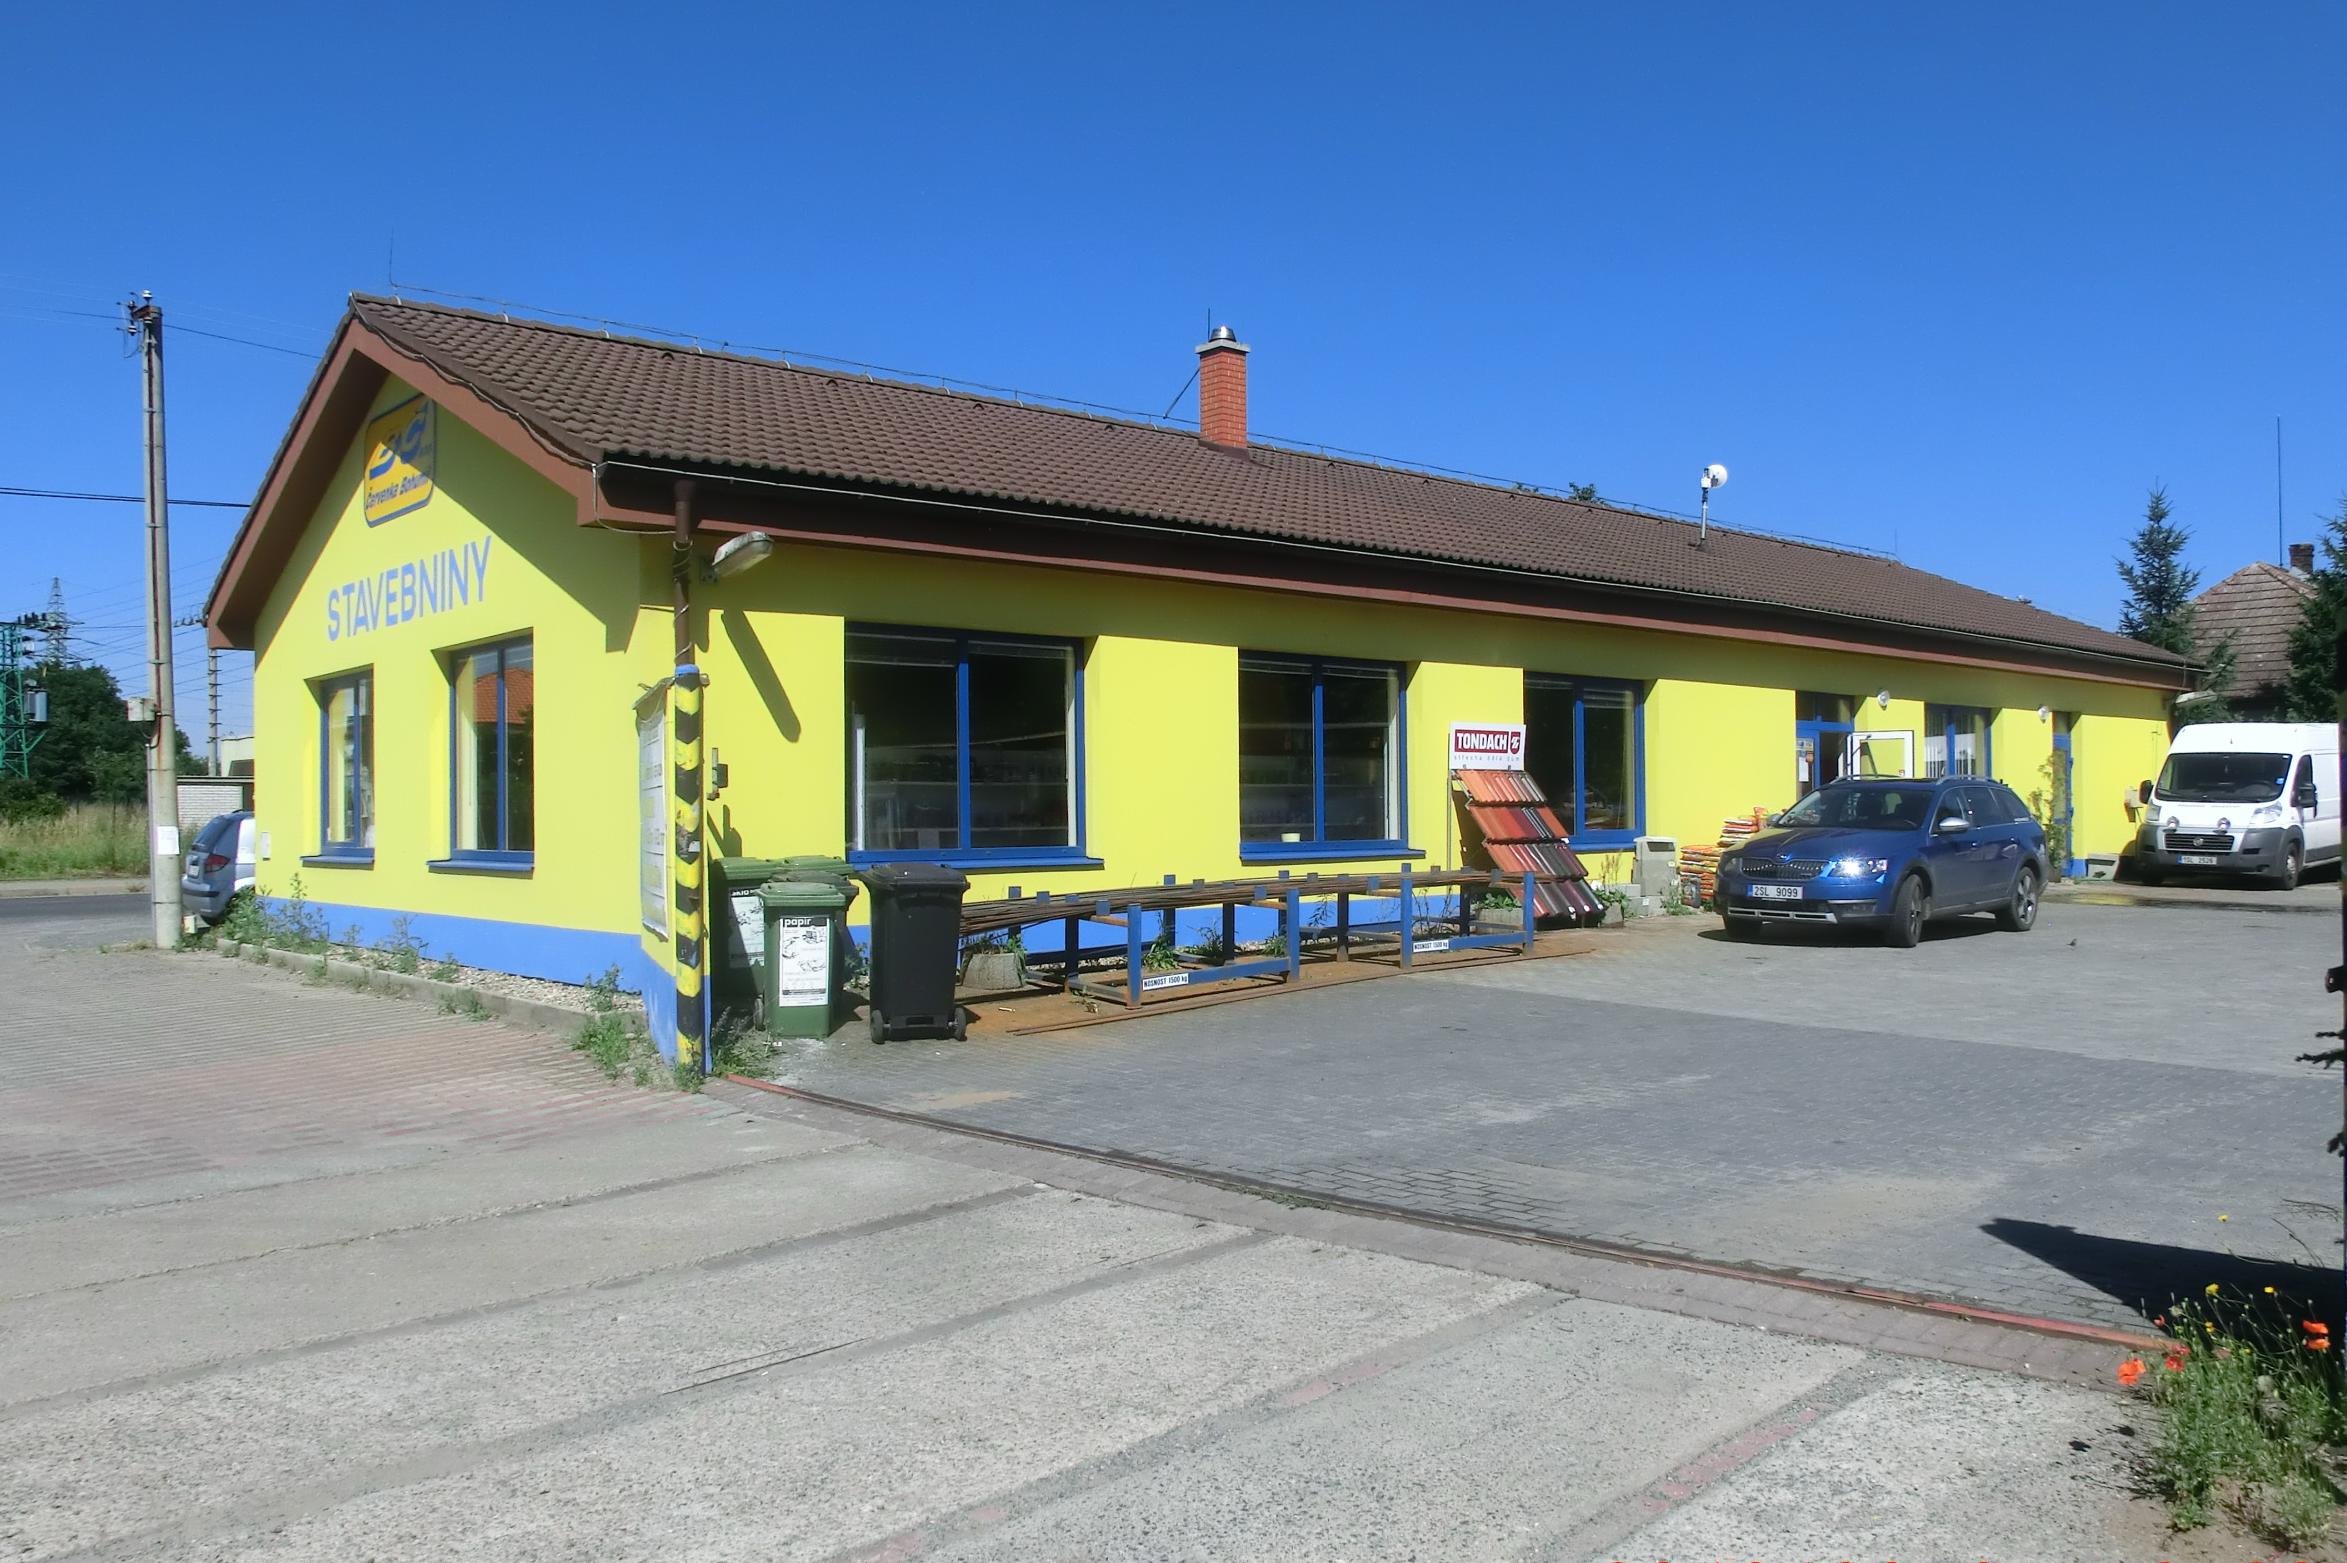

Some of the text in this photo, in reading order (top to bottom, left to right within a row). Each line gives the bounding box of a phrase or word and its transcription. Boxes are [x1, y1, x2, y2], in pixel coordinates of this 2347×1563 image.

[327, 536, 492, 641] STAVEBNINY
[1456, 733, 1507, 750] TONDACH
[1754, 886, 1798, 898] 2SL 9099
[1144, 978, 1167, 988] NOSNOST
[1168, 976, 1180, 984] 1500
